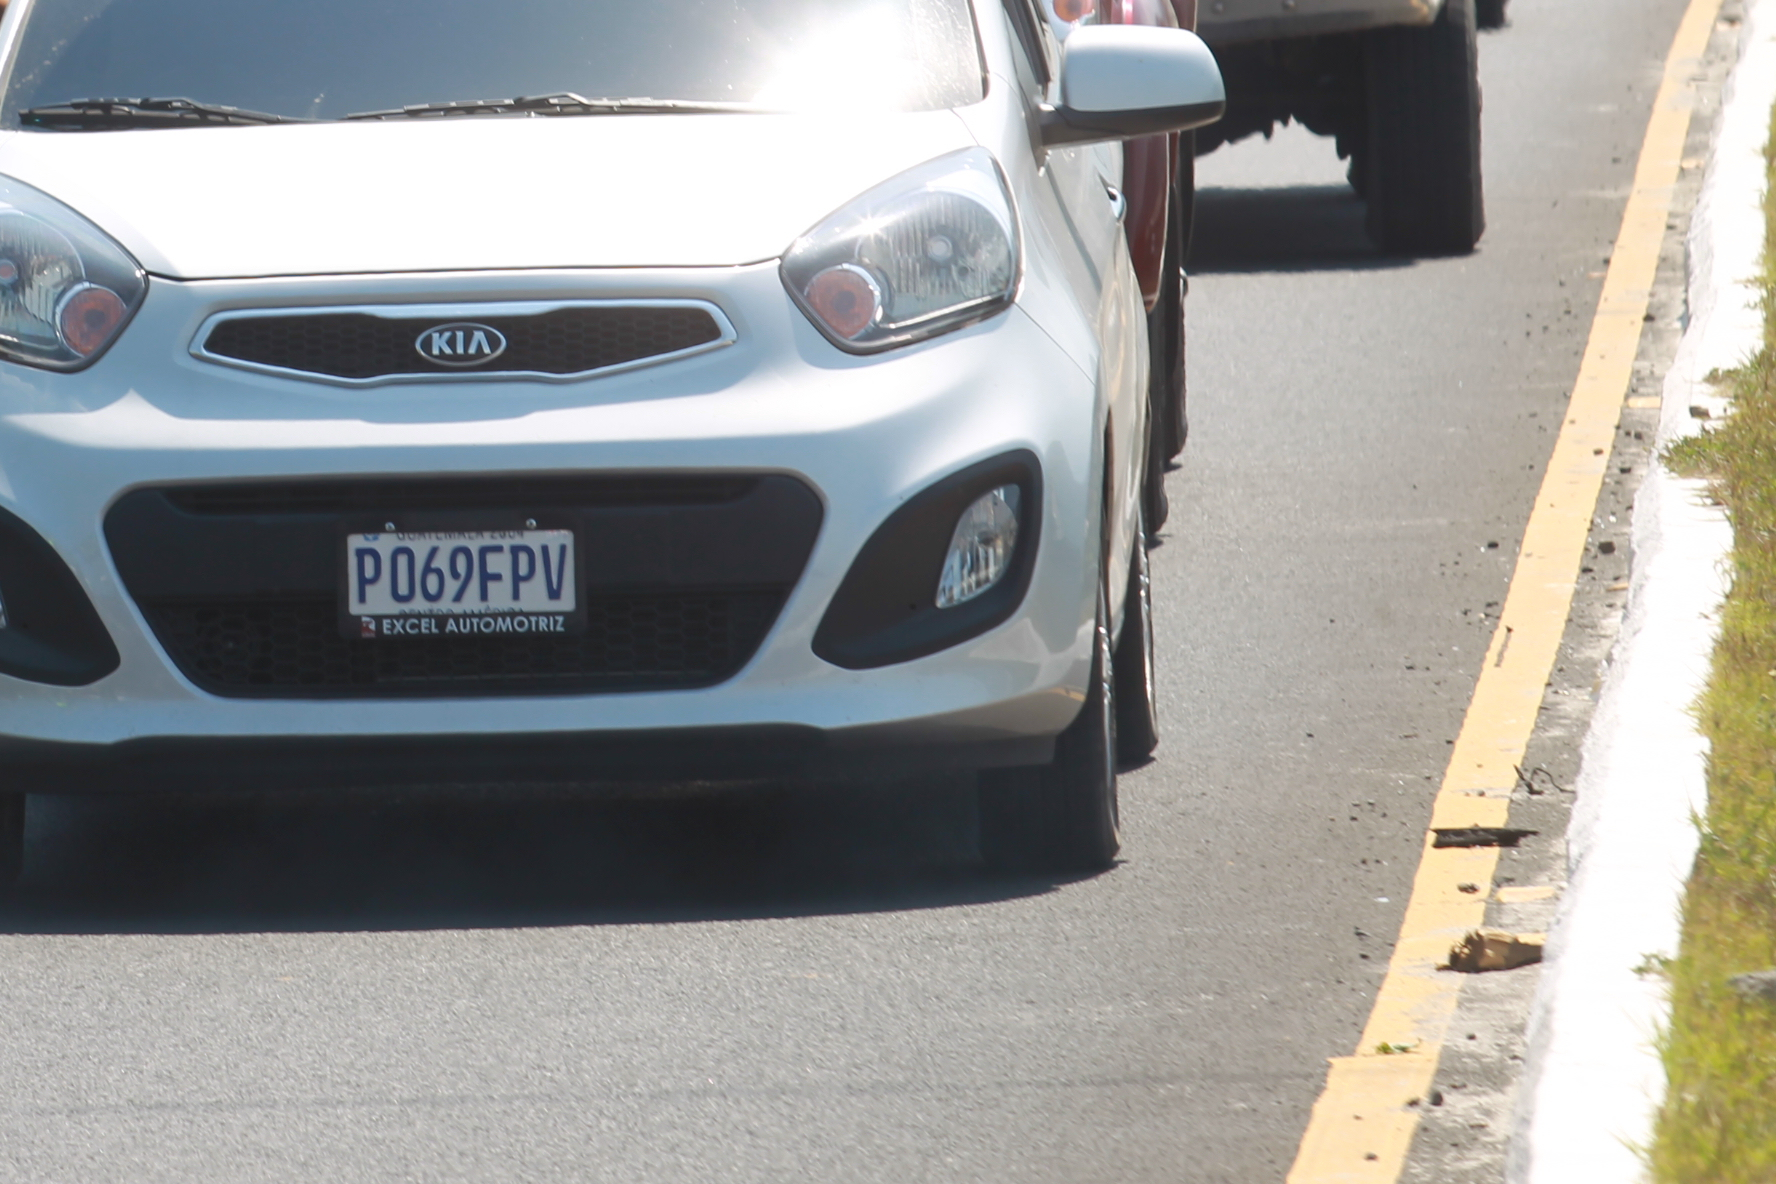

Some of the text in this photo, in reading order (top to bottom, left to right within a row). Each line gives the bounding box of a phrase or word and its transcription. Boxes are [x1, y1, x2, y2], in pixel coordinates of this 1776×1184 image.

[431, 329, 492, 356] KIA
[355, 543, 567, 605] P069FPV
[382, 615, 566, 635] EXCEL AUTOMOTRIZ
